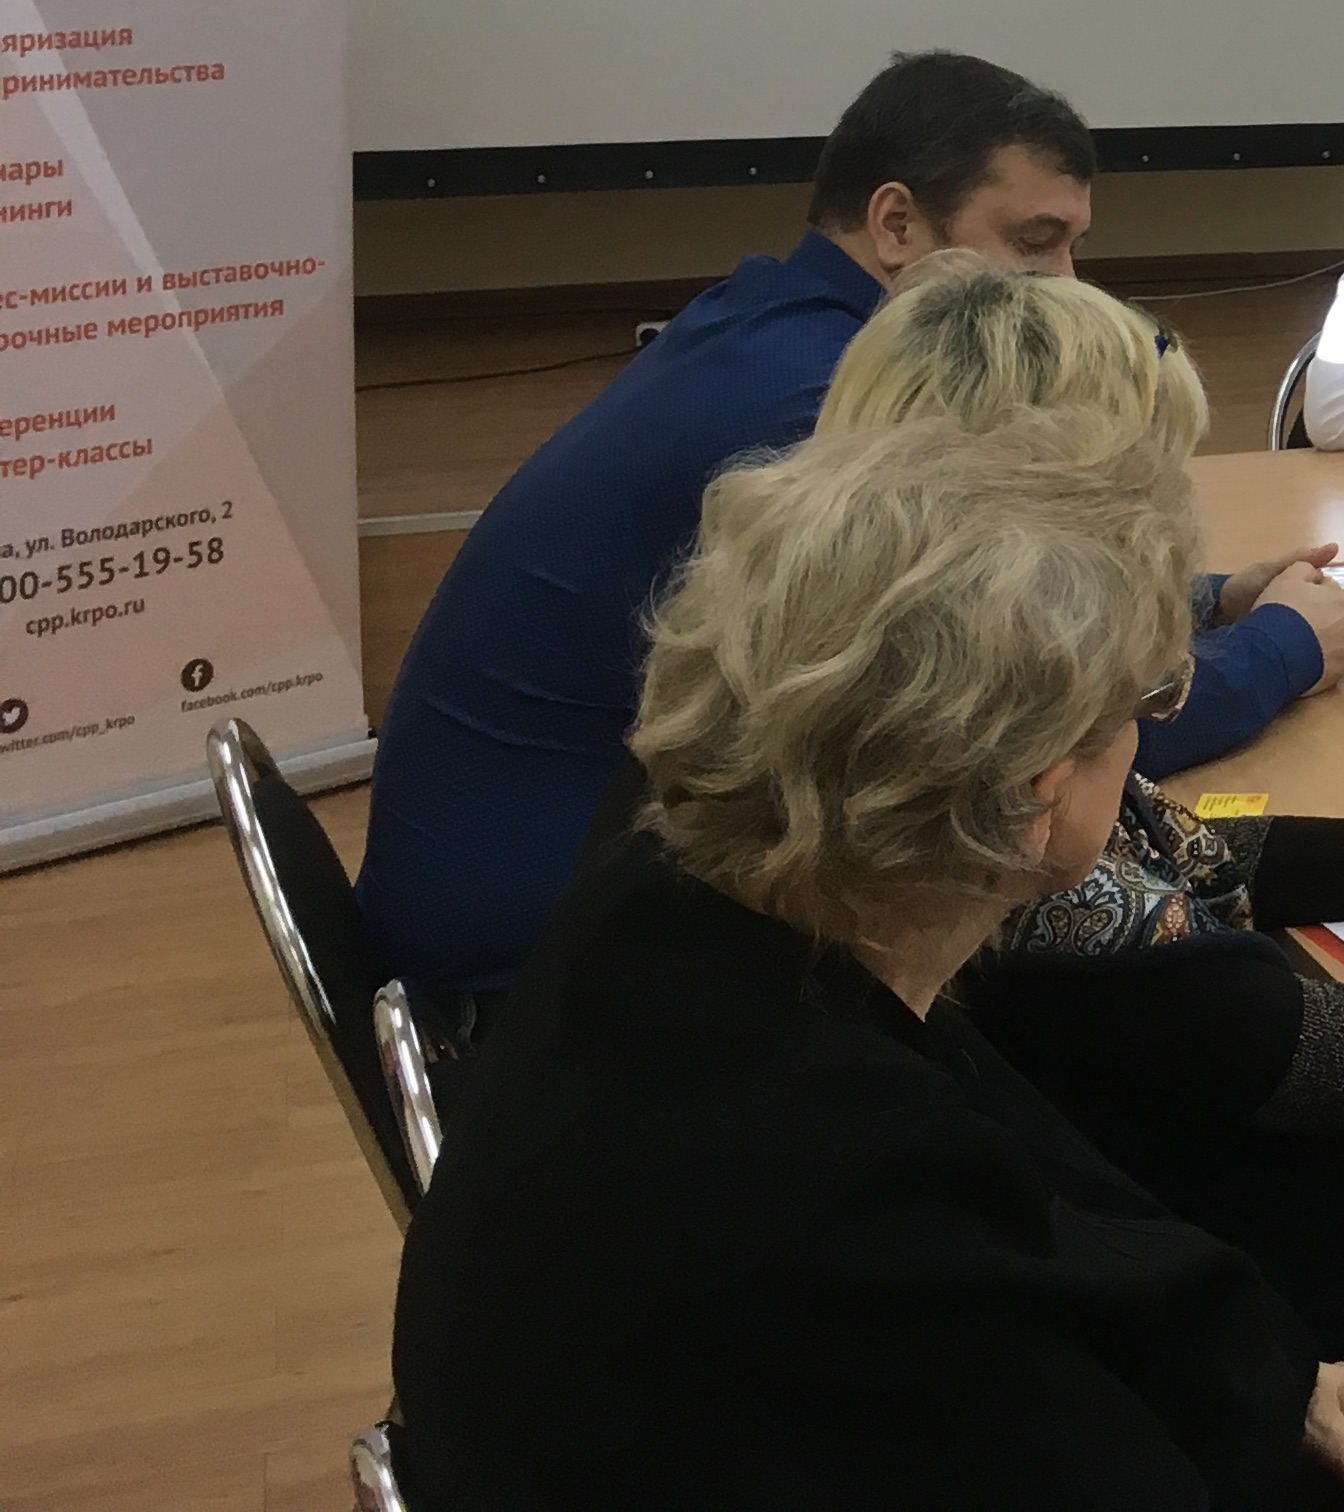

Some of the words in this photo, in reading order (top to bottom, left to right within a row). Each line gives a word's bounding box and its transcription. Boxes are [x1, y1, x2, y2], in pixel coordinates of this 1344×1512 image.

[2, 27, 133, 58] яризация
[2, 62, 226, 100] ринимательства
[137, 275, 152, 293] и
[162, 256, 326, 291] выставочно-
[107, 298, 285, 338] мероприятия
[1, 543, 21, 559] а,
[25, 536, 54, 559] ул.
[61, 508, 217, 548] Володарского,
[222, 500, 233, 519] 2
[26, 598, 146, 638] cpp.krpo.ru
[181, 672, 324, 713] facebook.com/cpp.krpo
